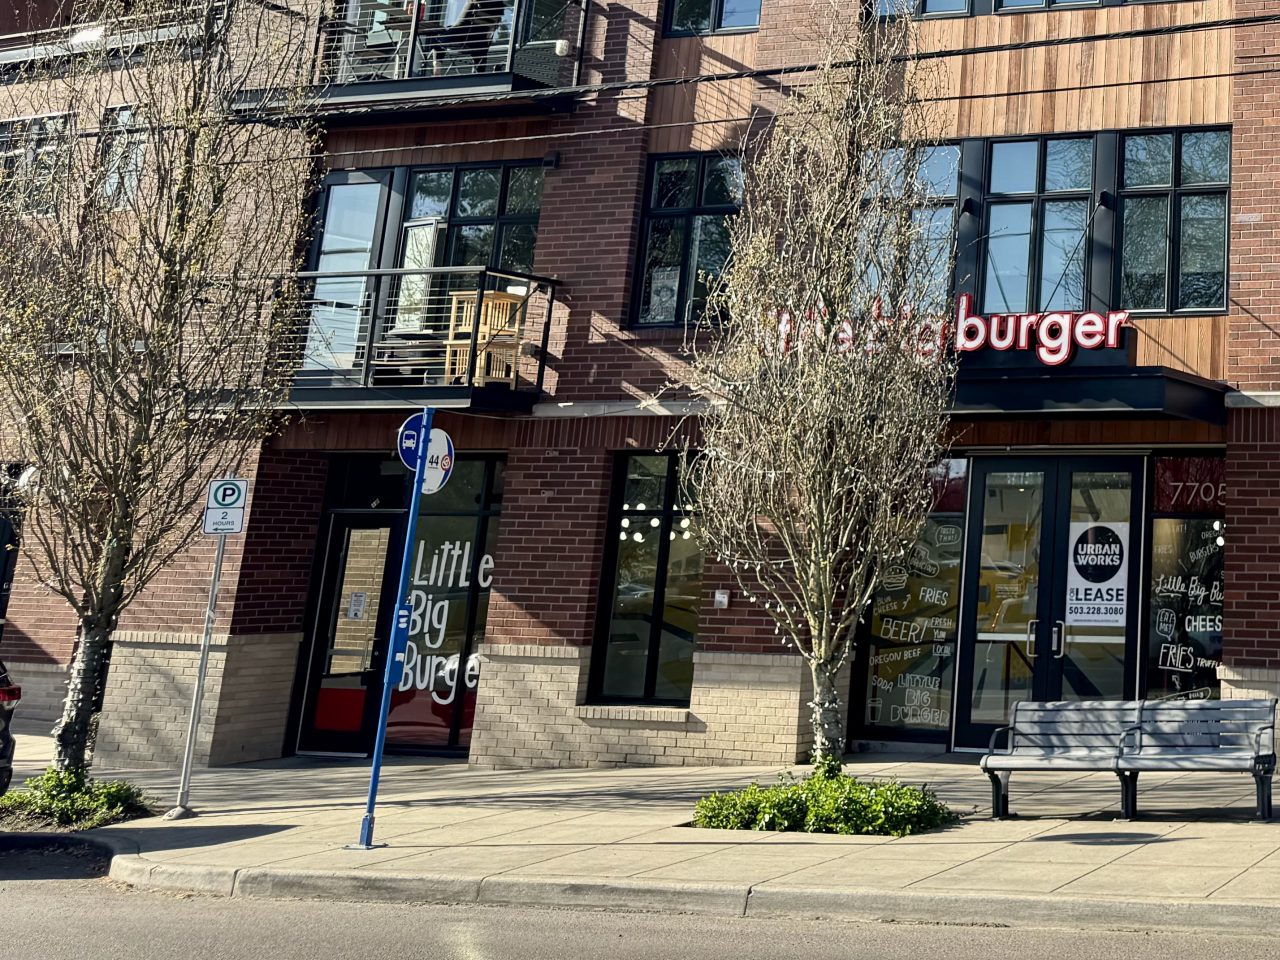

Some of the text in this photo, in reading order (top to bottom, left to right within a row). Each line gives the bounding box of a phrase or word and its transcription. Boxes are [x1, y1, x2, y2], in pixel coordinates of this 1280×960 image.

[953, 292, 1129, 366] burger
[428, 454, 439, 466] 44
[221, 487, 236, 502] P
[1169, 482, 1226, 506] 7705
[221, 511, 229, 520] 2
[1078, 543, 1120, 555] URBAN
[1189, 543, 1219, 563] BURGERS
[1076, 555, 1120, 566] WORKS
[1075, 587, 1125, 602] LEASE
[1155, 574, 1187, 594] Little
[1188, 576, 1209, 606] Big
[408, 589, 450, 648] Big
[1069, 606, 1124, 615] 503.228.3080
[880, 617, 928, 644] BEER!
[931, 617, 953, 628] FRESH
[1185, 615, 1223, 632] CHEES
[869, 648, 922, 666] OREGON BEEF
[932, 644, 951, 655] LOCAL
[871, 675, 894, 693] SODA
[890, 705, 950, 726] BURGER
